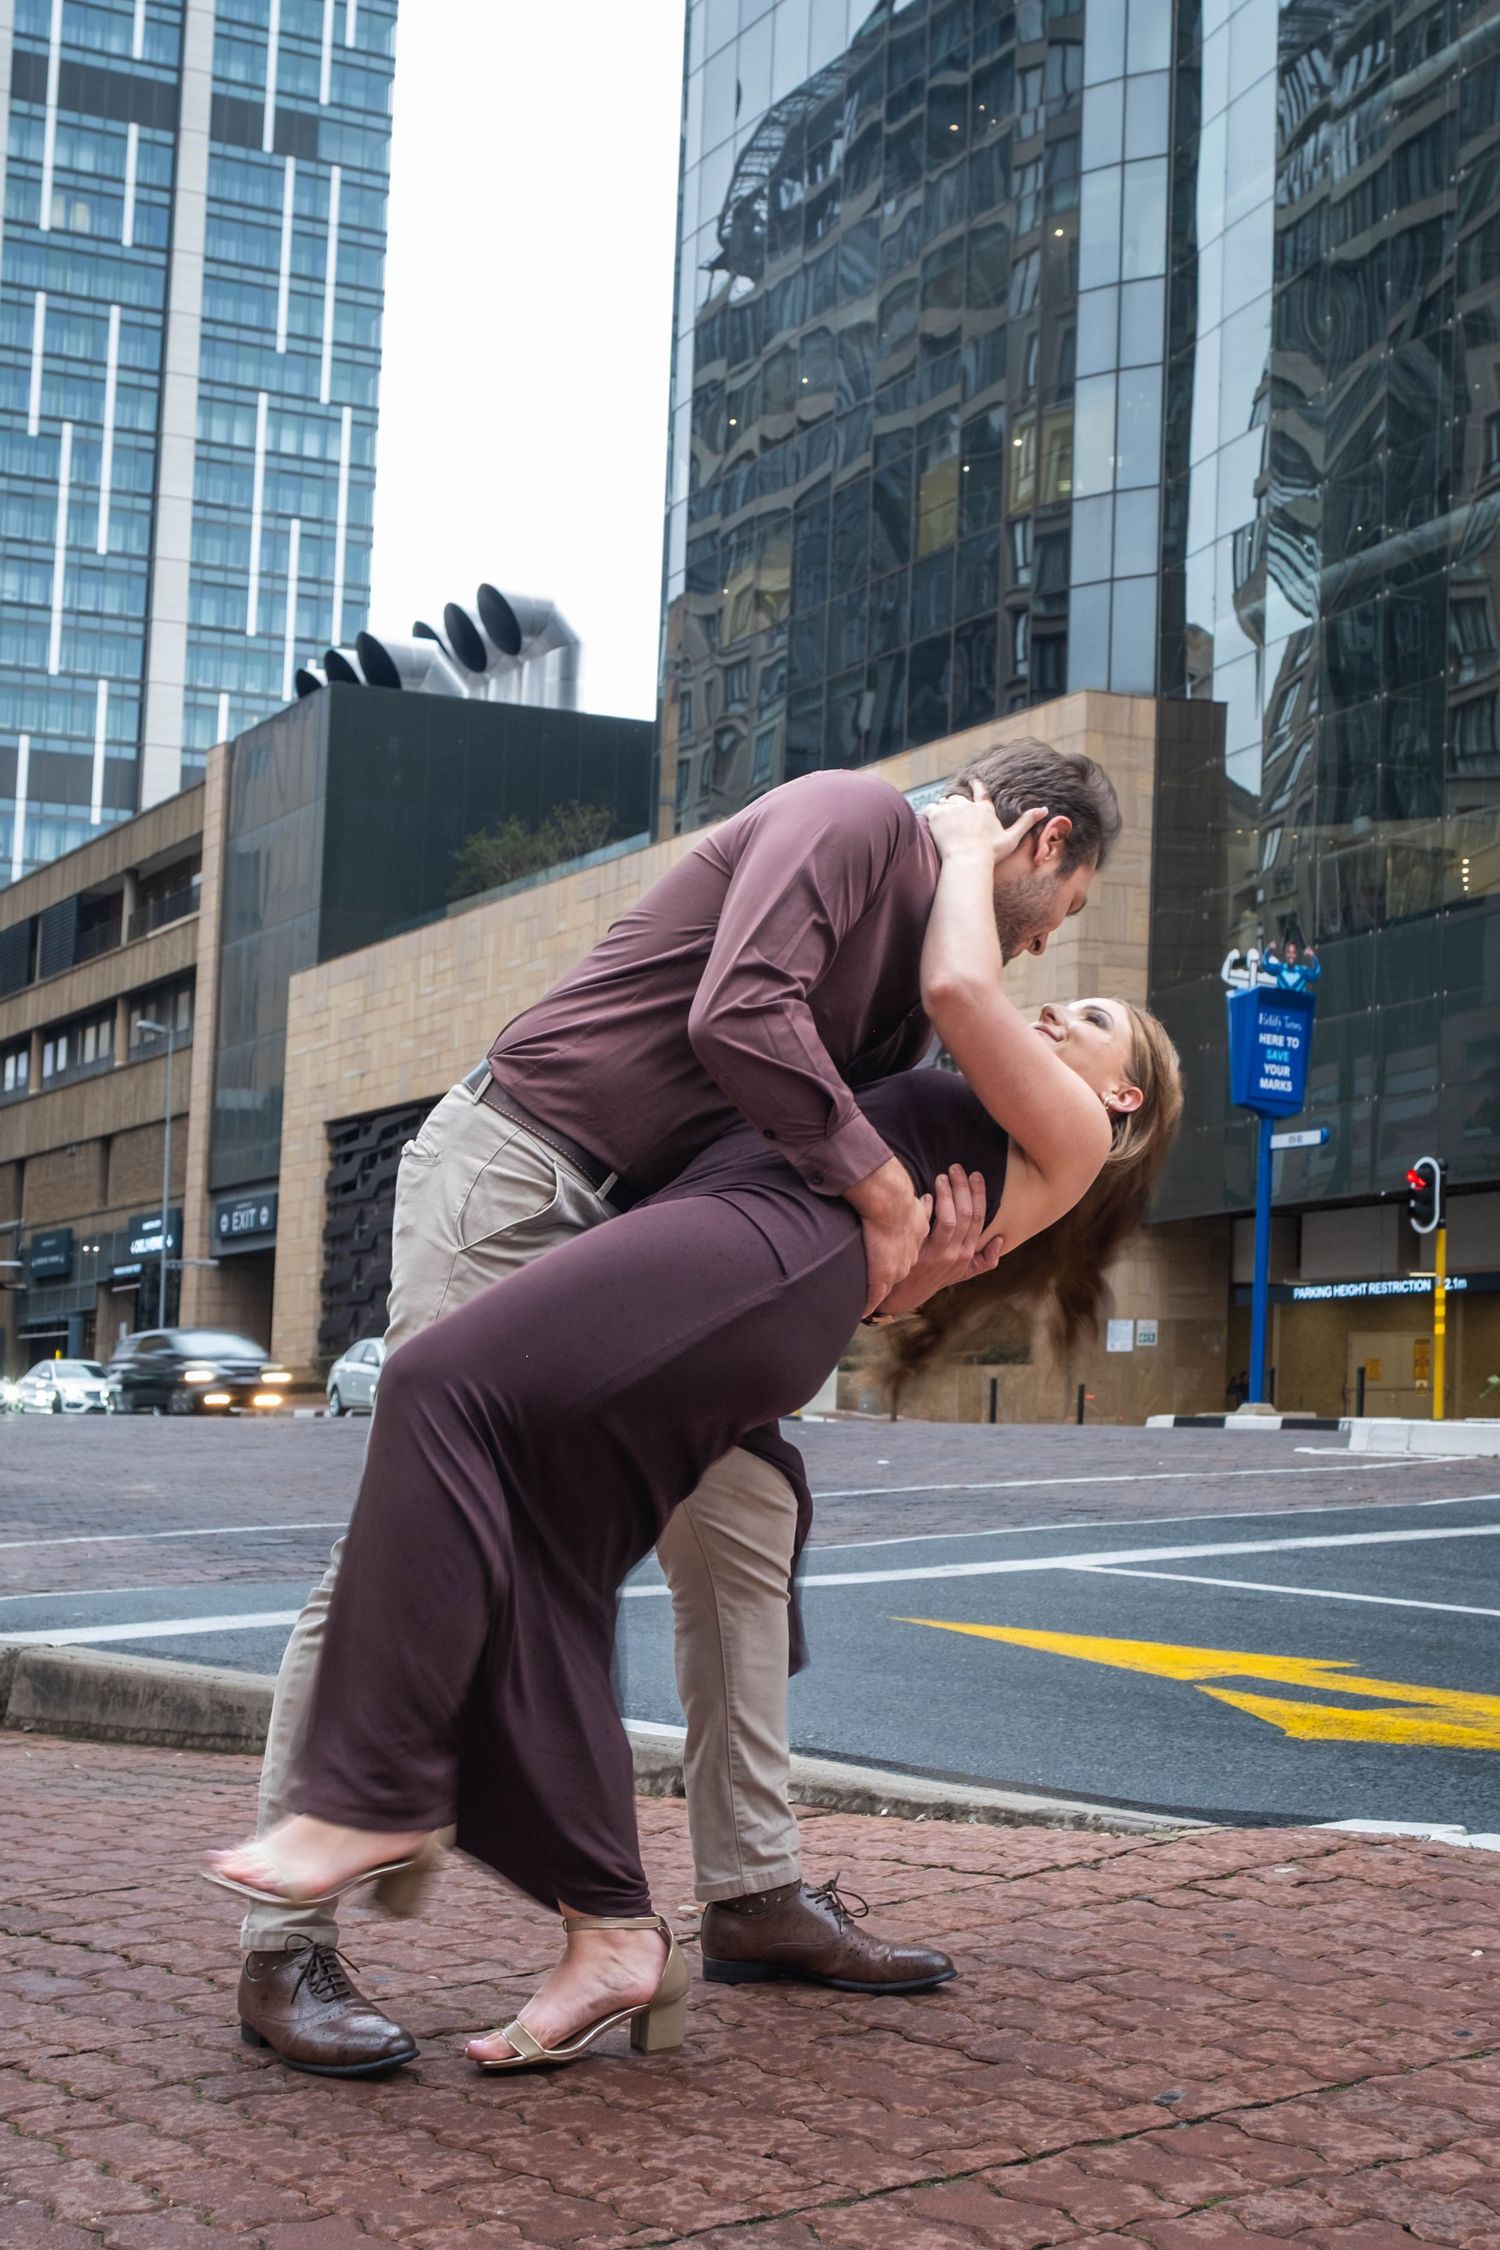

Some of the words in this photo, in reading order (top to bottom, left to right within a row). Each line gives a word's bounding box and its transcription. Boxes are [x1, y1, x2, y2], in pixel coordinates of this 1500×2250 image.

[1259, 1033, 1285, 1048] HERE
[1286, 1036, 1300, 1049] TO
[1266, 1049, 1290, 1063] SAVE
[1263, 1063, 1291, 1078] YOUR
[1259, 1078, 1293, 1093] MARKS
[232, 1208, 256, 1231] EXIT
[1293, 1285, 1332, 1299] PARKING
[1333, 1282, 1367, 1297] HEIGHT
[1368, 1279, 1432, 1295] RESTRICTION
[1444, 1277, 1467, 1291] 2.1m
